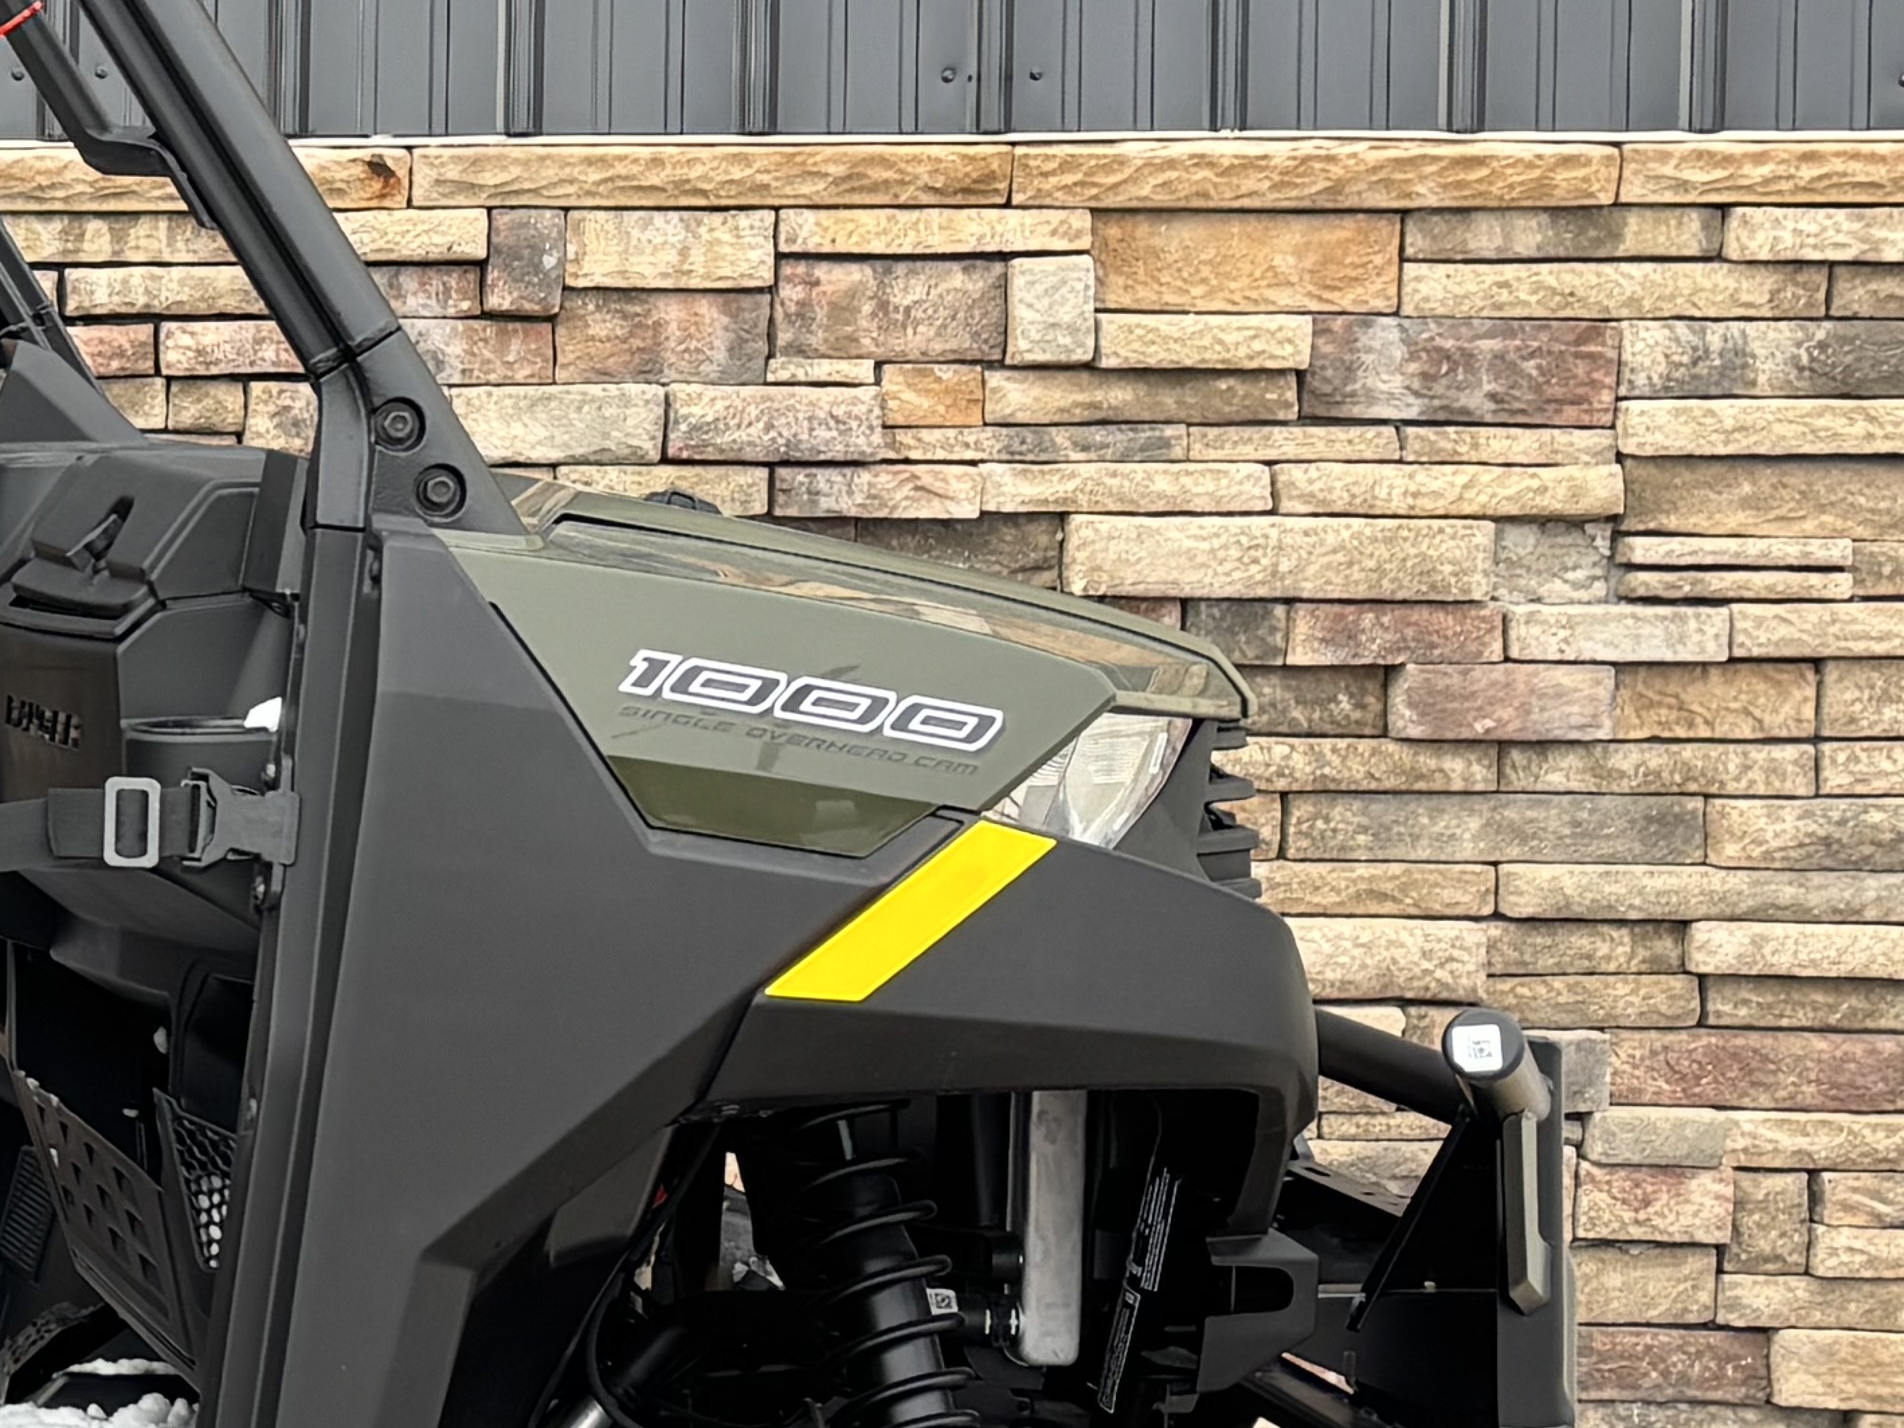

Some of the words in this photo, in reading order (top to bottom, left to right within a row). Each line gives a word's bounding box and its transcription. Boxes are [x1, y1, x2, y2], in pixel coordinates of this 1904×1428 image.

[618, 648, 1004, 752] 1000
[618, 704, 733, 733] SINGLE
[745, 726, 906, 762] OVERHEAD
[909, 755, 980, 776] CAM
